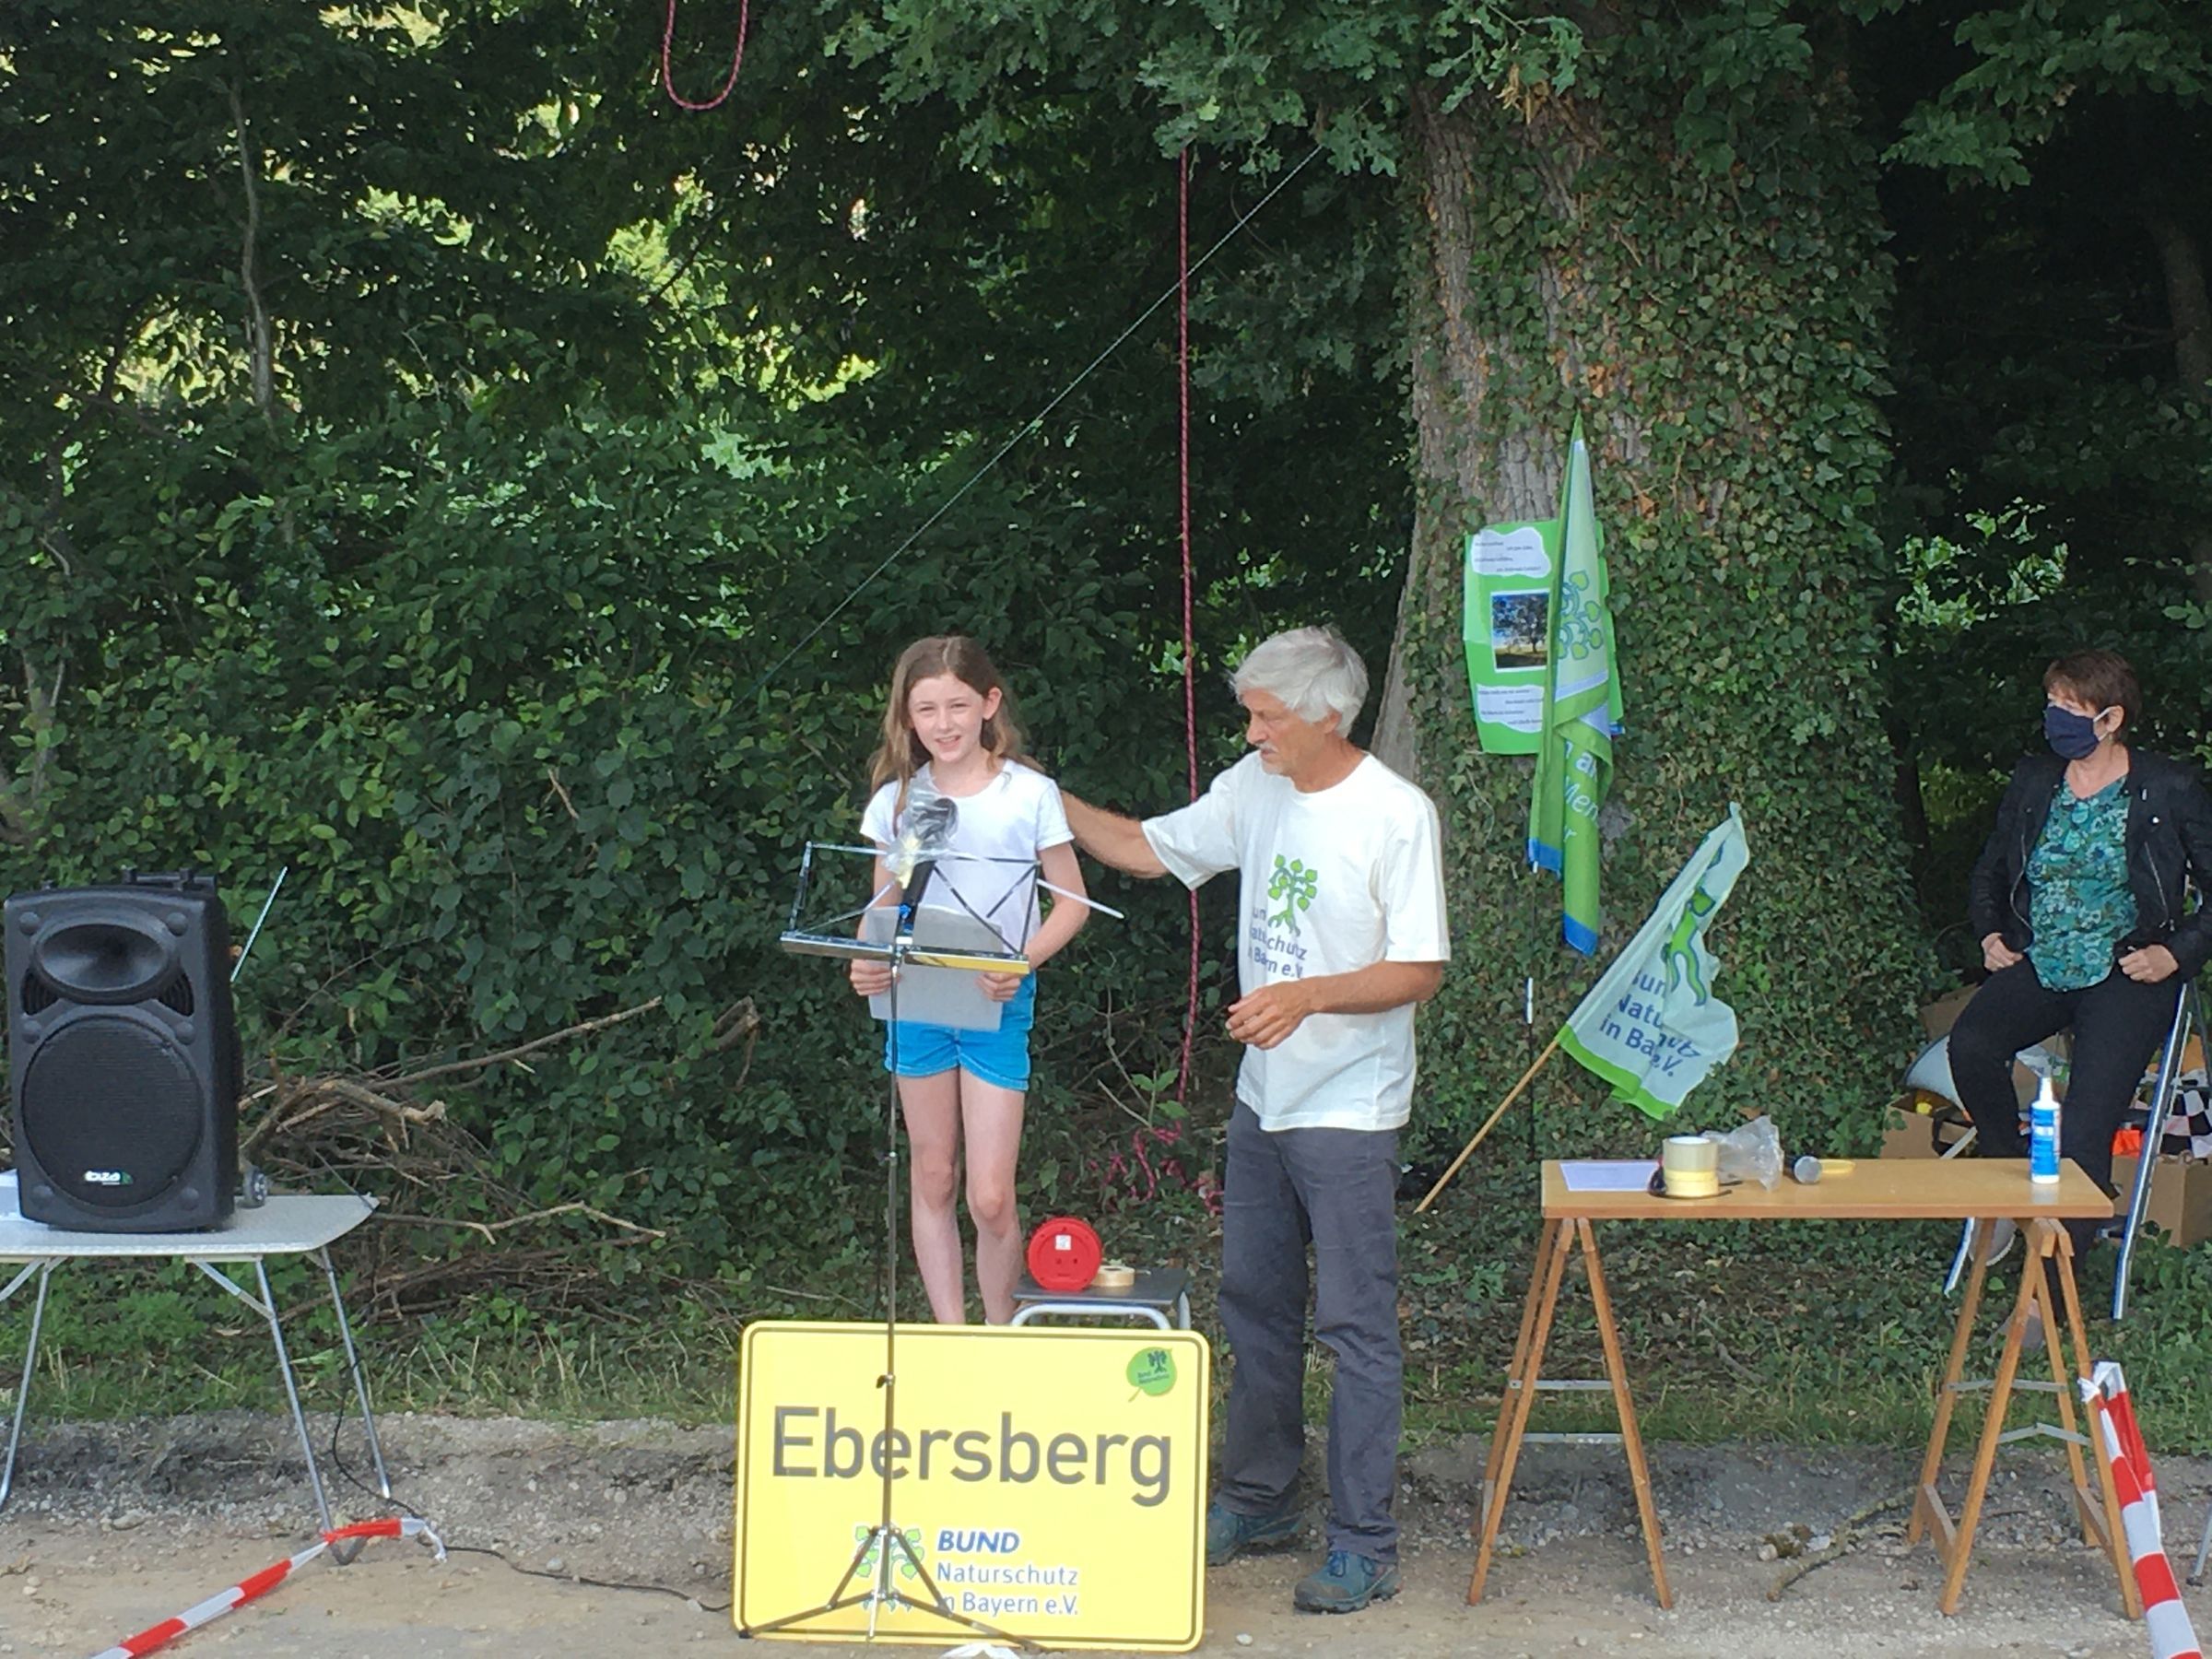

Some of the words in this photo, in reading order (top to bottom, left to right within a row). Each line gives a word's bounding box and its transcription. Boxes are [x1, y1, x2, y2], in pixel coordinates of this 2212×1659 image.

[1599, 1012, 1621, 1041] in
[771, 1406, 1171, 1507] Ebersberg
[937, 1529, 1020, 1554] BUND
[937, 1561, 1078, 1586] Naturschutz
[962, 1592, 1039, 1618] Bayern
[1045, 1594, 1078, 1616] e.V.
